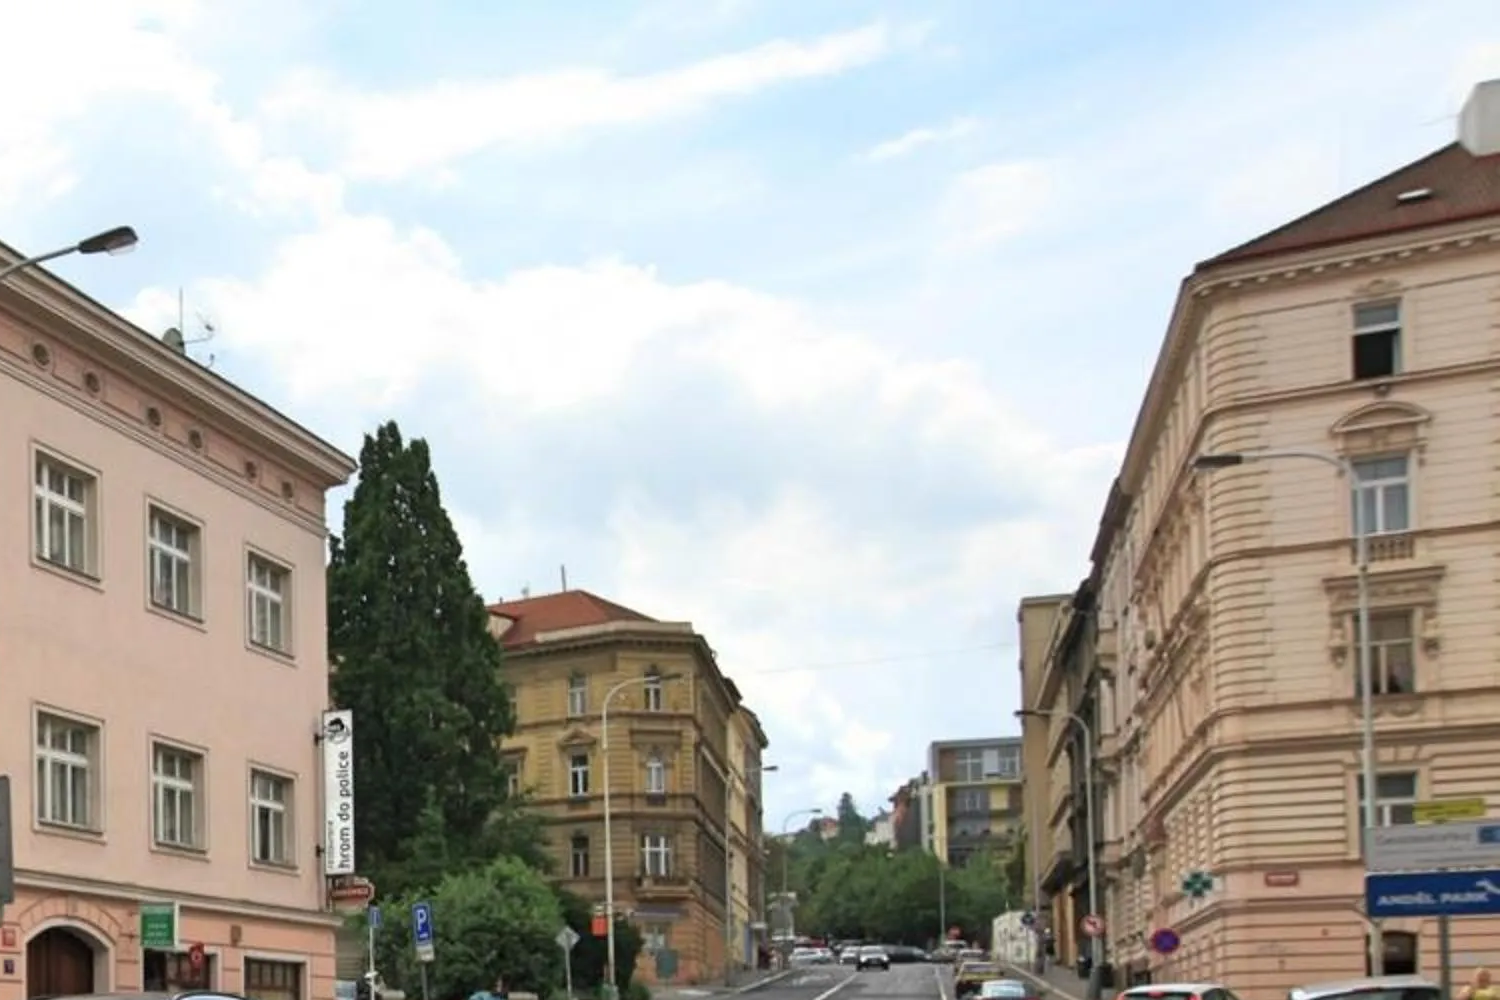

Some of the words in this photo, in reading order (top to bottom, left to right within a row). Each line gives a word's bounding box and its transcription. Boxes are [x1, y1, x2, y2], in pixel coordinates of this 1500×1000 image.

[337, 751, 352, 798] police
[336, 802, 351, 821] do
[338, 827, 351, 869] hrom
[416, 908, 427, 930] P
